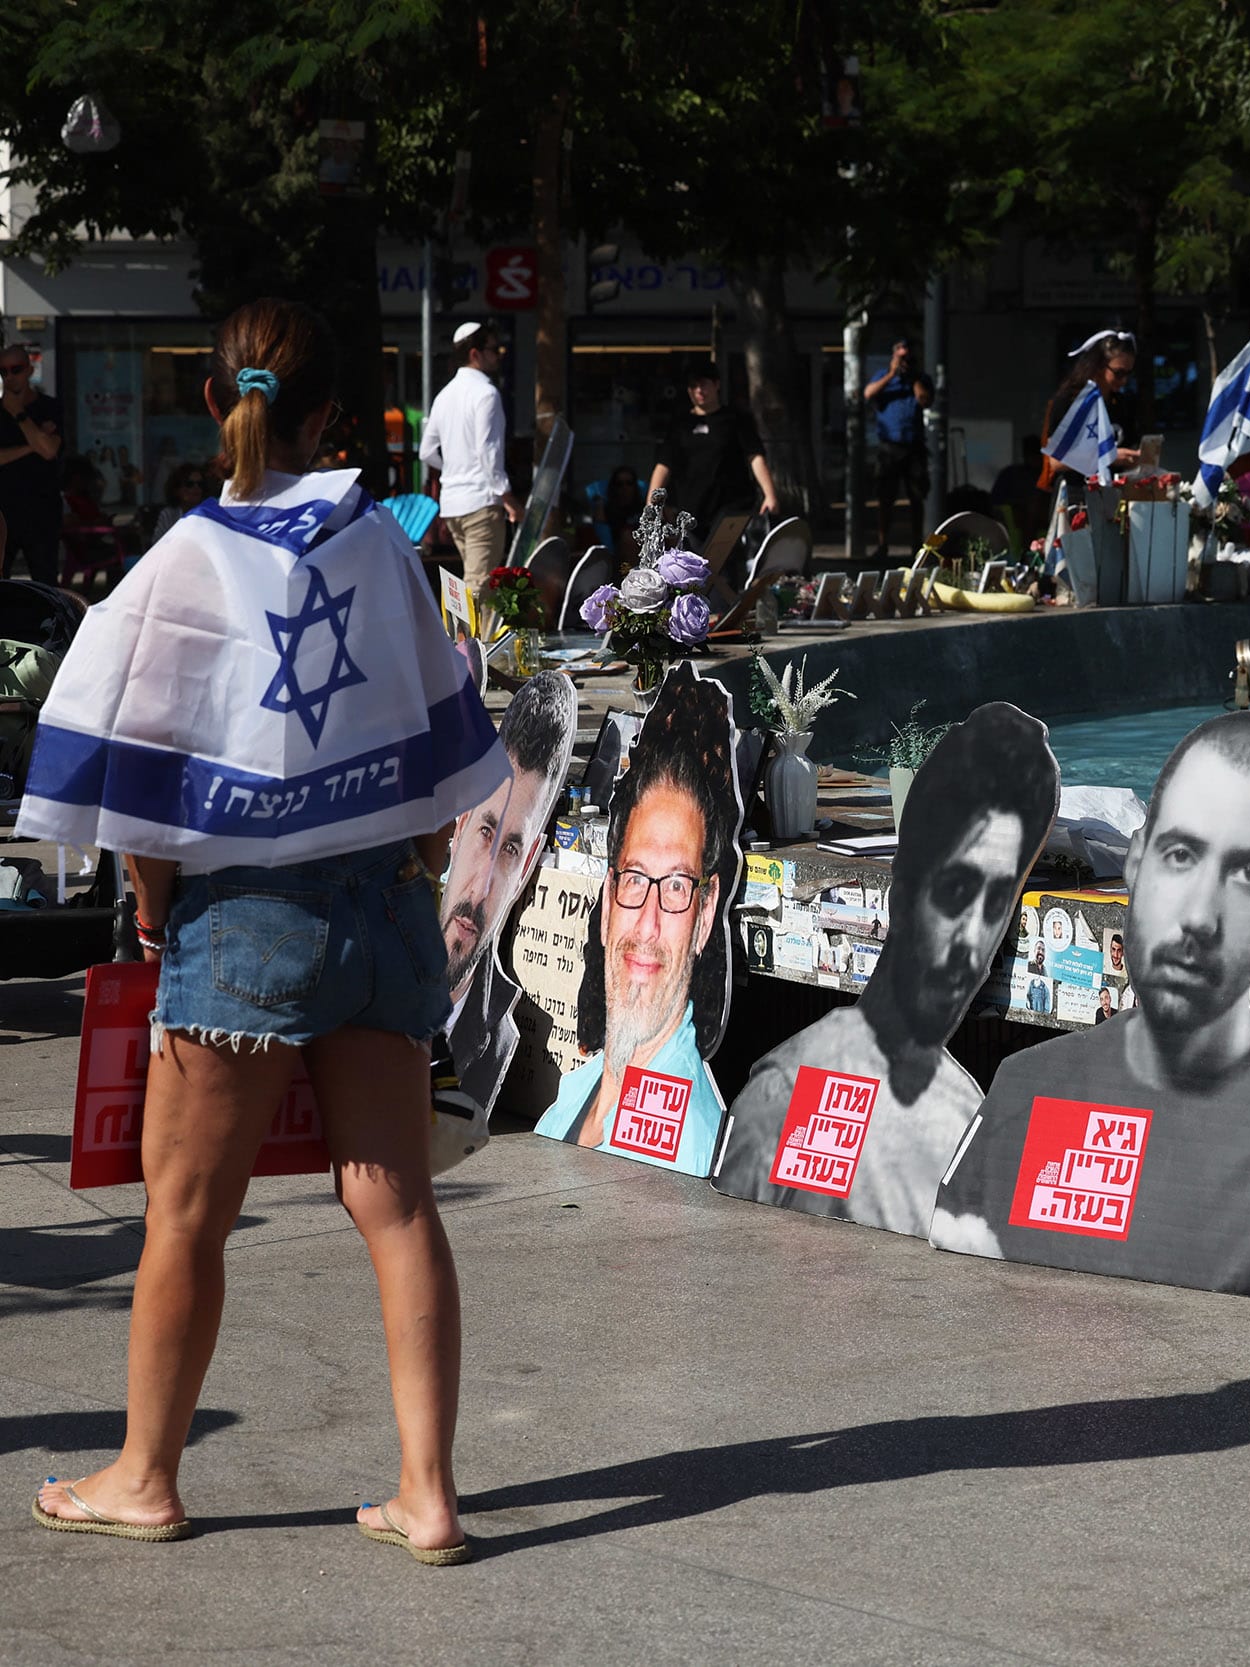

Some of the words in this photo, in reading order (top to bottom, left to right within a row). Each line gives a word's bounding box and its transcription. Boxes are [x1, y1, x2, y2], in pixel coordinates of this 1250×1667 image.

[325, 756, 400, 803] ביחד
[204, 775, 310, 819] ננצח!
[558, 889, 596, 920] אסף
[522, 948, 547, 967] בחיפה
[640, 1079, 685, 1113] עדיין
[824, 1082, 871, 1114] מתן
[621, 1115, 676, 1151] בעזה.
[808, 1117, 861, 1149] עדיין
[1092, 1119, 1137, 1151] גיא
[786, 1152, 850, 1186] בעזה.
[1065, 1152, 1134, 1186] עדיין
[1041, 1191, 1124, 1226] בעזה.
